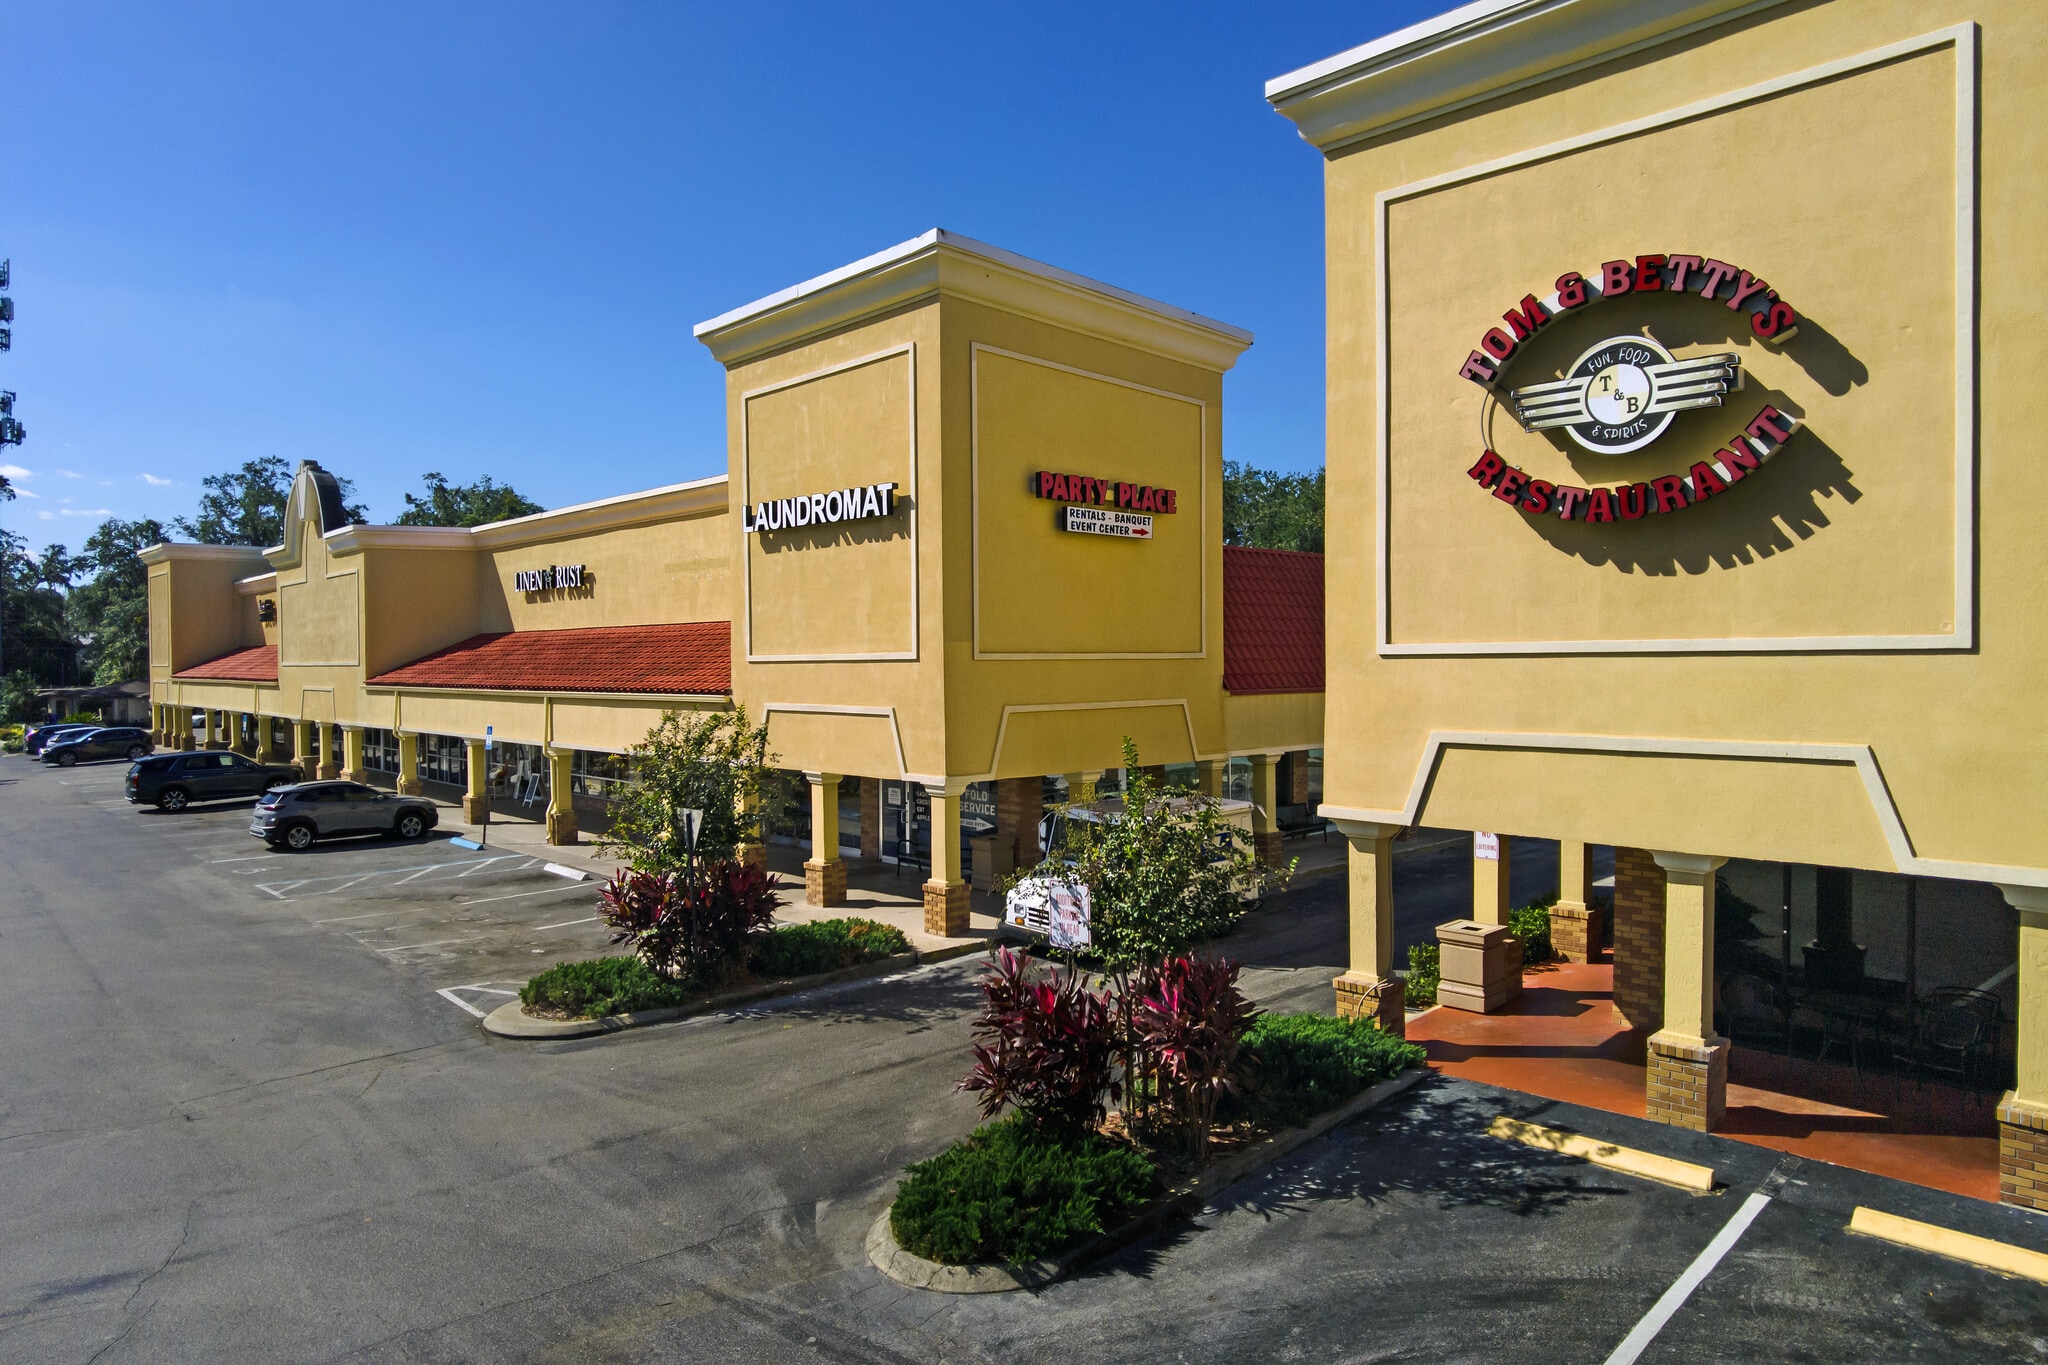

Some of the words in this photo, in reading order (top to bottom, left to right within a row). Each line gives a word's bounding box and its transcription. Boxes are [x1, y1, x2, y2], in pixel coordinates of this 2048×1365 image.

[1458, 293, 1550, 382] TOM
[1555, 271, 1588, 308] &
[1600, 254, 1795, 338] BETTY'S
[1587, 352, 1614, 373] FUN,
[1618, 347, 1651, 366] FOOD
[1599, 375, 1612, 392] T
[1613, 389, 1625, 401] &
[1626, 396, 1639, 413] B
[1591, 424, 1602, 437] &
[1602, 418, 1648, 440] SPIRITS
[1467, 404, 1792, 523] RESTAURANT
[1040, 471, 1109, 505] PARTY
[1118, 482, 1177, 514] PLACE
[741, 482, 894, 533] LAUNDROMAT
[1069, 508, 1106, 522] RENTALS
[1114, 513, 1152, 527] BANQUET
[1070, 520, 1097, 533] EVENT
[1099, 523, 1130, 536] CENTER
[514, 569, 543, 592] LINEN
[555, 565, 582, 588] RUST
[960, 801, 996, 816] SERVICE
[965, 789, 988, 802] FOLD
[1481, 831, 1491, 839] NO
